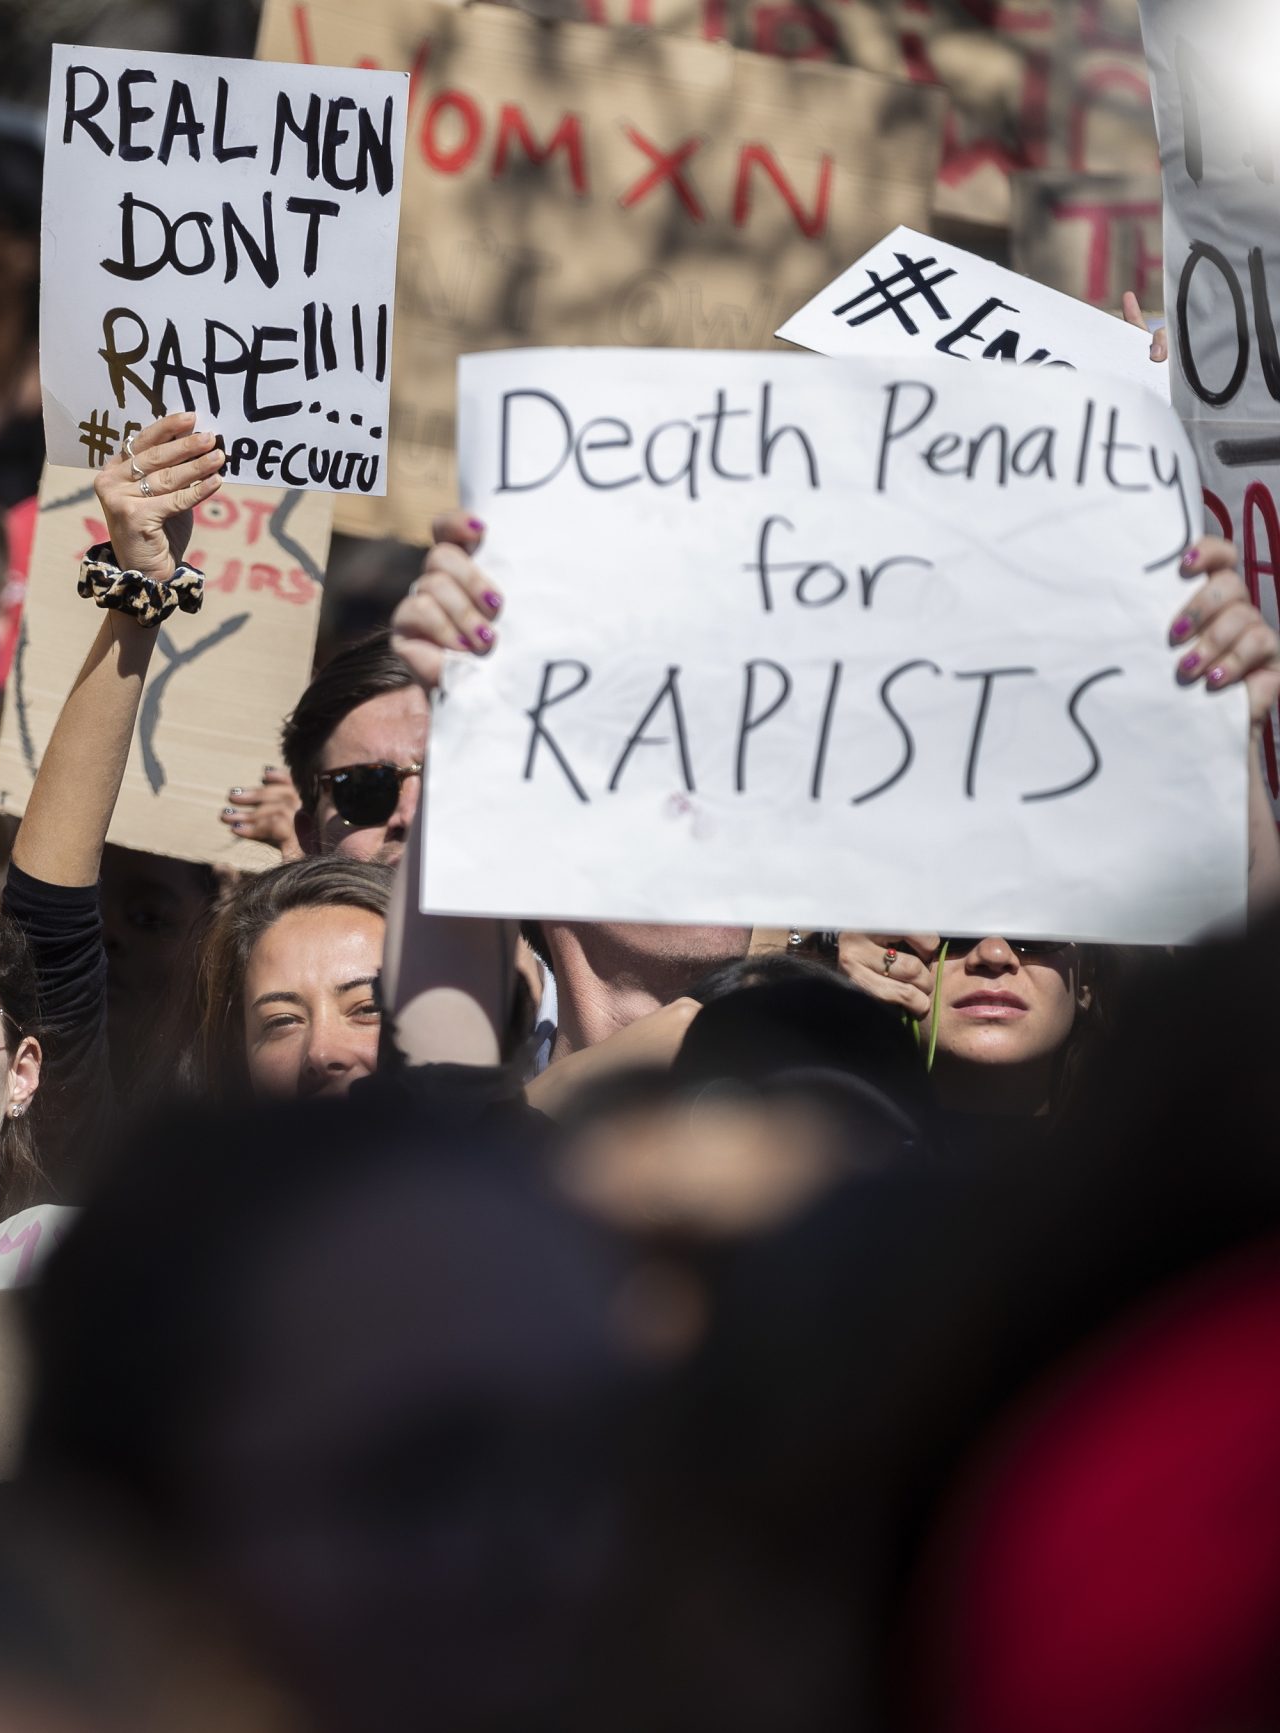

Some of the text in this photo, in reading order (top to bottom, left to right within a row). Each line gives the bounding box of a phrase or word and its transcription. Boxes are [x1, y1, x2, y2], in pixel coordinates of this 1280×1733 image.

[63, 64, 394, 197] REAL MEN
[99, 190, 341, 289] DONT
[493, 380, 821, 501] Death
[873, 381, 1195, 573] Penalty
[742, 516, 935, 613] for
[523, 658, 1125, 805] RAPISTS
